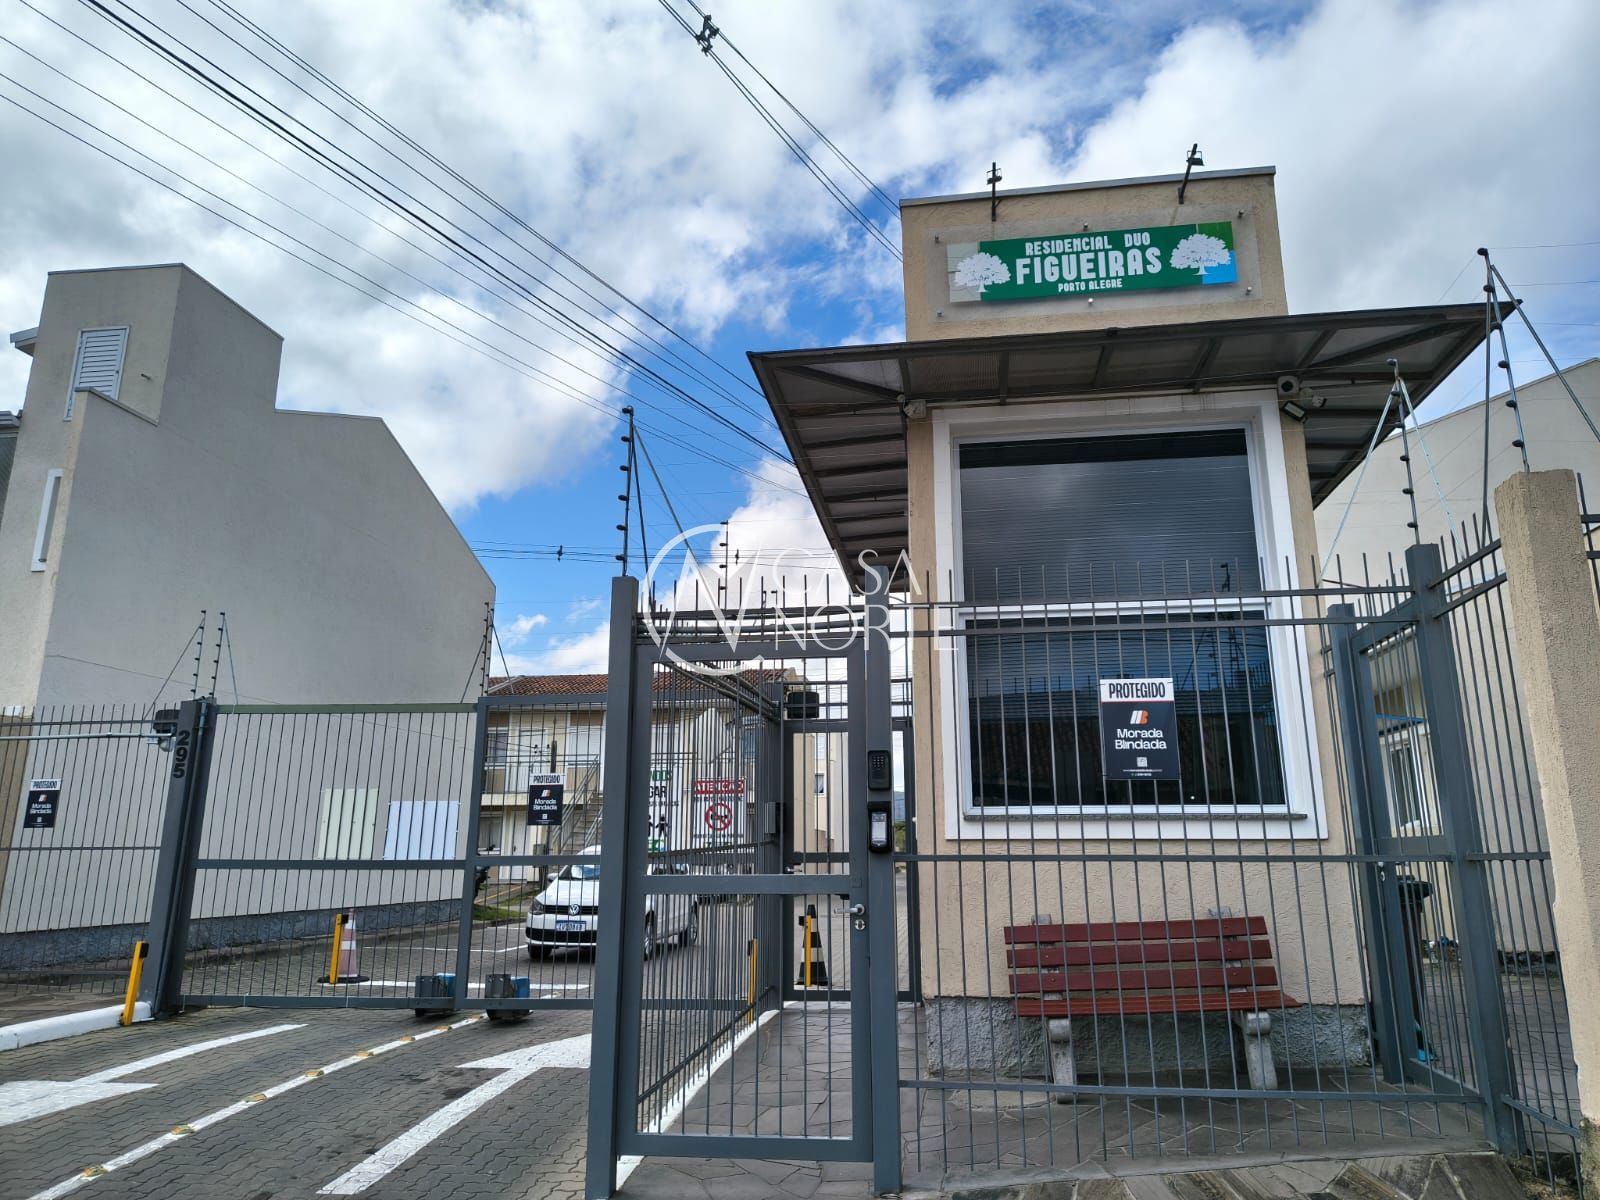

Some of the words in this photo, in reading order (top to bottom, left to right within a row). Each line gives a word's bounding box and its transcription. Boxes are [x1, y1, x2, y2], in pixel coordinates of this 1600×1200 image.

[1025, 235, 1112, 256] RESIDENCIAL
[1124, 231, 1151, 247] DUO
[1015, 246, 1163, 285] FIGUEIRAS
[1058, 281, 1086, 293] PORTO
[1088, 278, 1123, 290] ALEGRE
[1108, 682, 1166, 699] PROTEGIDO
[1116, 728, 1163, 739] Morada
[1114, 739, 1168, 750] Blindada
[173, 729, 190, 779] 295
